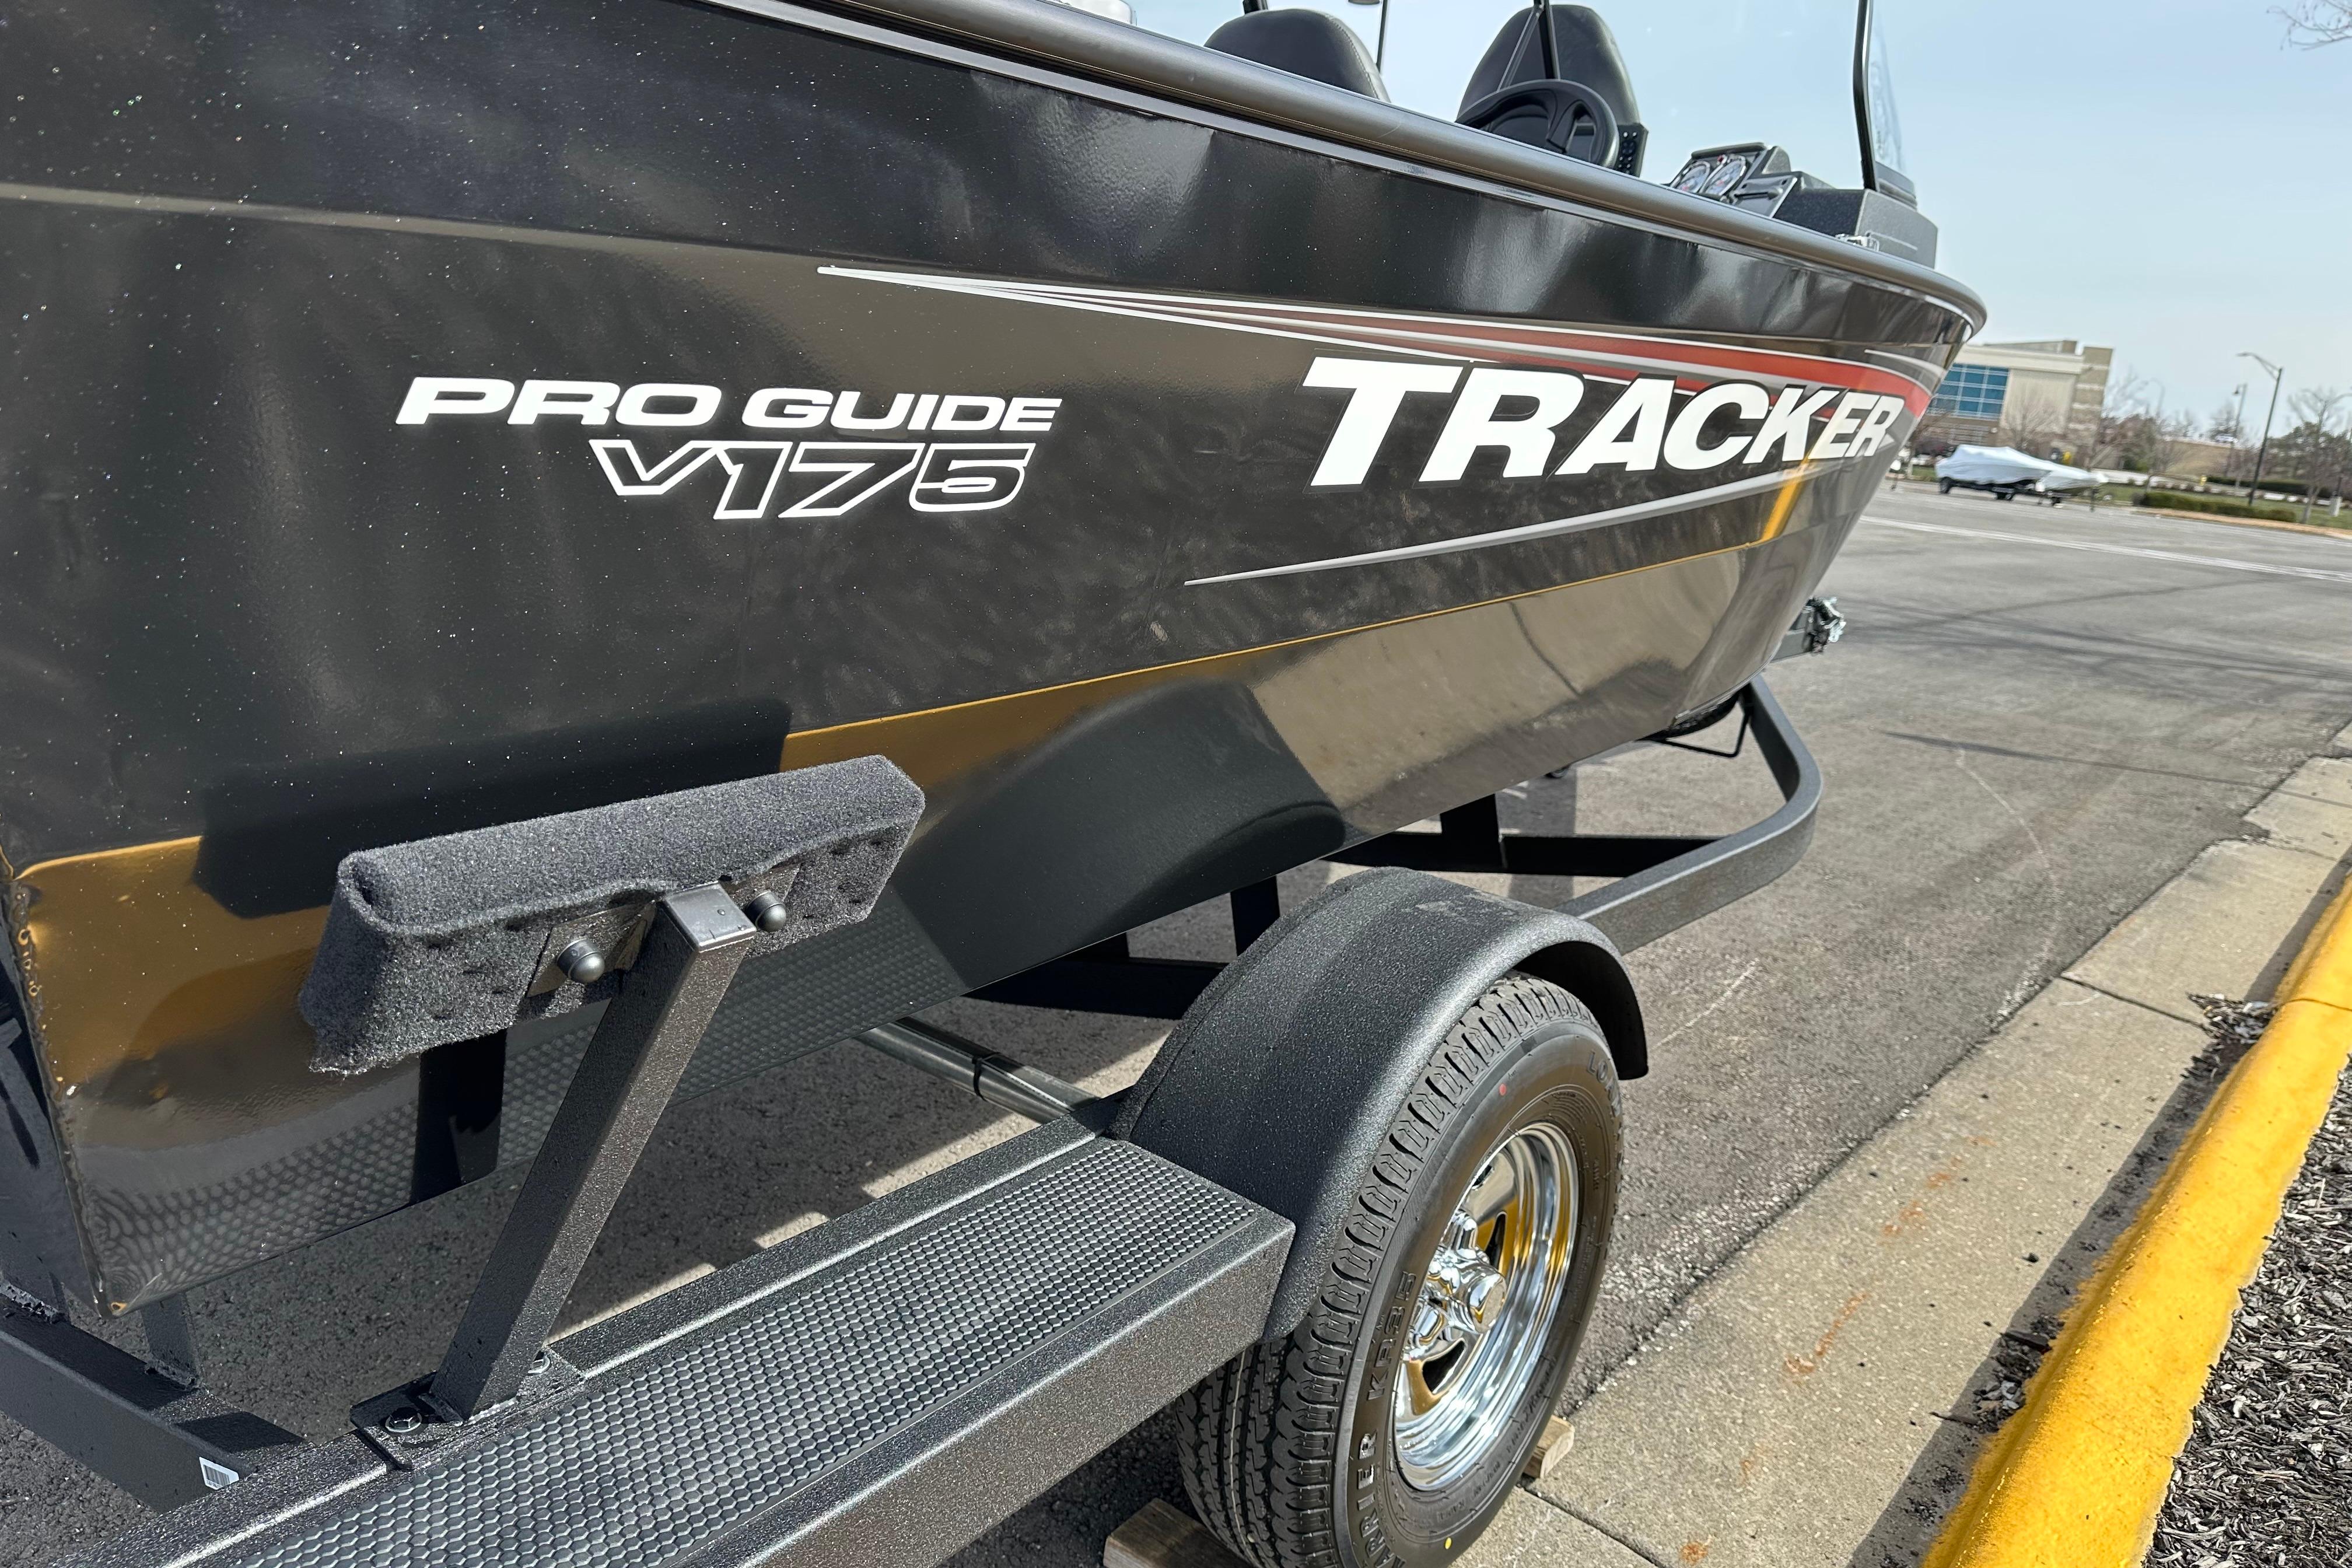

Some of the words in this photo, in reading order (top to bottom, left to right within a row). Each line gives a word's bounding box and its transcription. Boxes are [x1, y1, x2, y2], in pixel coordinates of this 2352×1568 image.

[396, 377, 722, 426] PRO
[741, 387, 1063, 432] GUIDE
[1303, 356, 1905, 486] TRACKER
[588, 439, 1036, 520] V175
[1367, 1270, 1416, 1401] KR35
